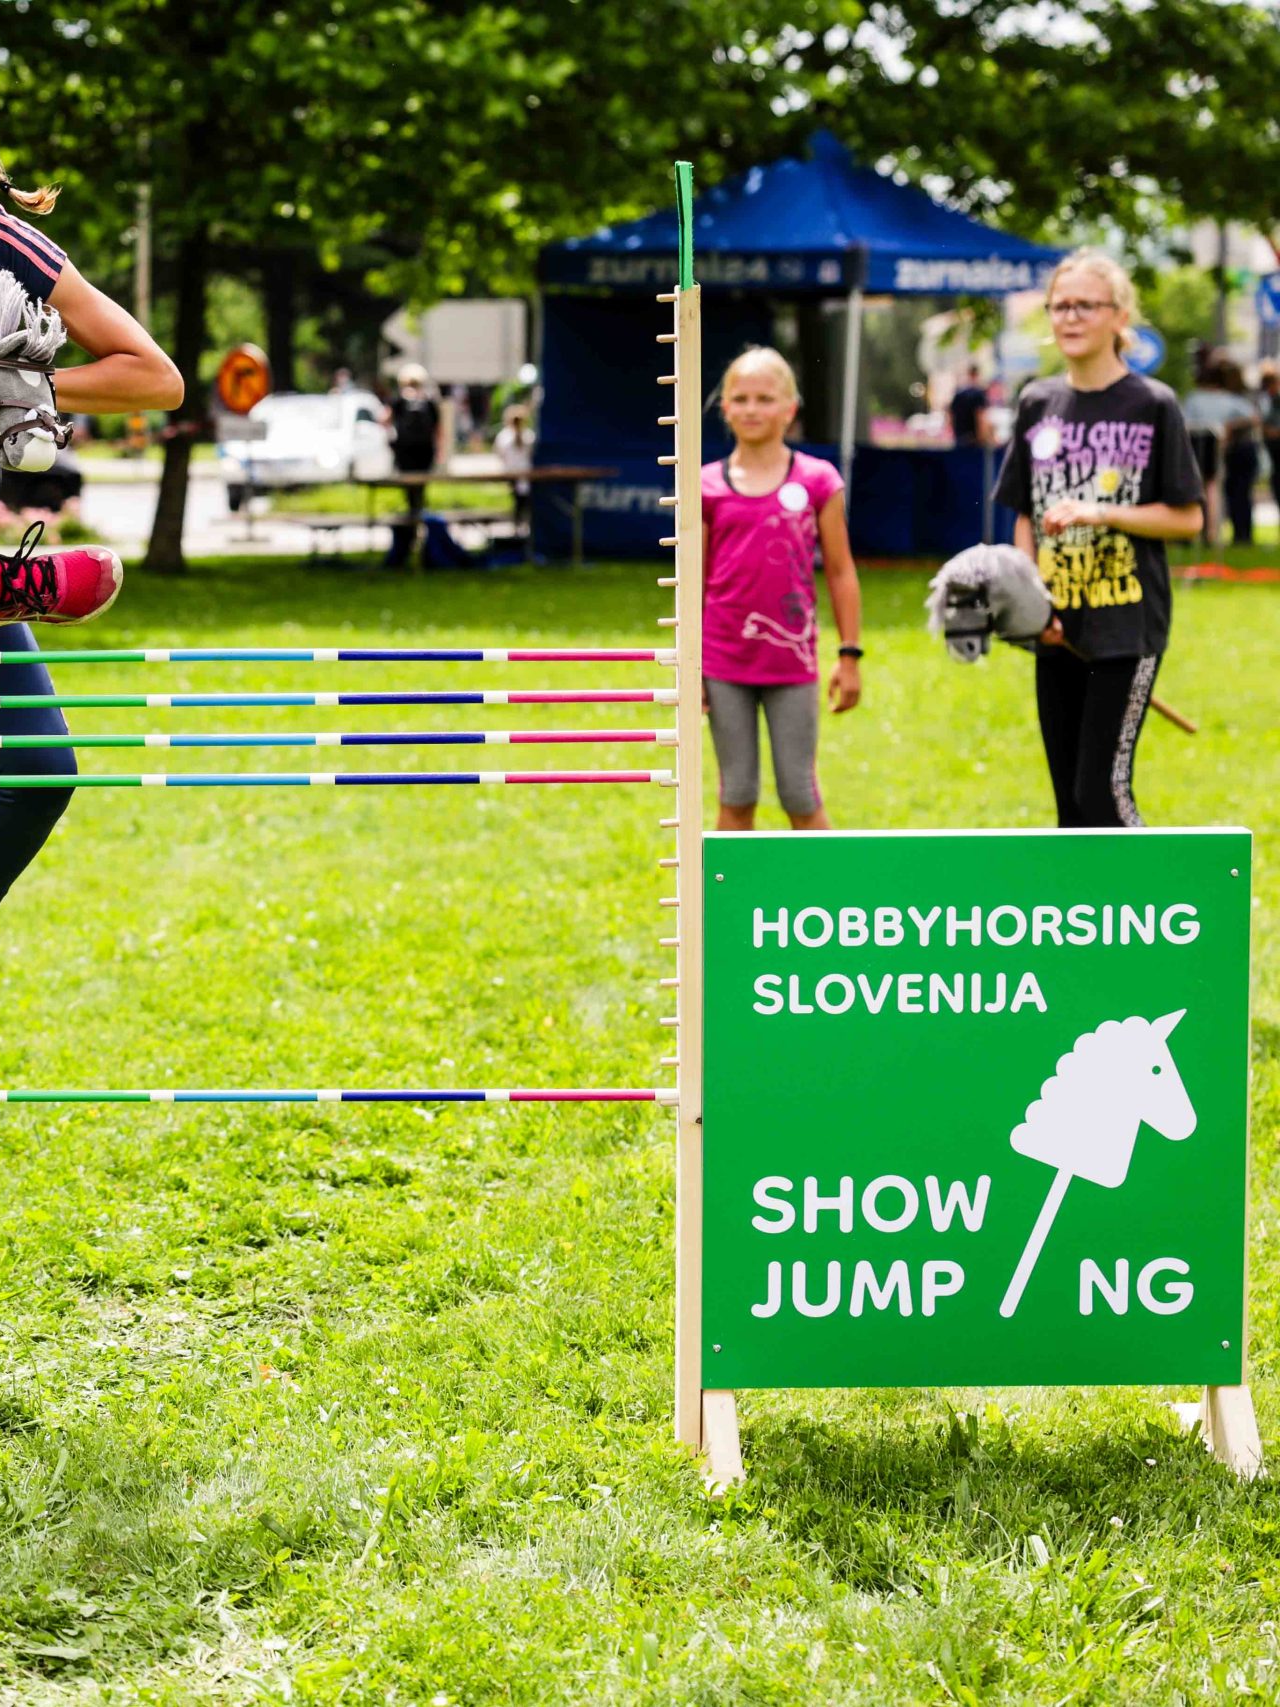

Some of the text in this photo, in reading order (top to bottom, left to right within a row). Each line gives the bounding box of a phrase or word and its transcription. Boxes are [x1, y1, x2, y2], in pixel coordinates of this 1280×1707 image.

[752, 902, 1201, 949] HOBBYHORSING
[751, 971, 1048, 1015] SLOVENIJA
[751, 1174, 992, 1234] SHOW
